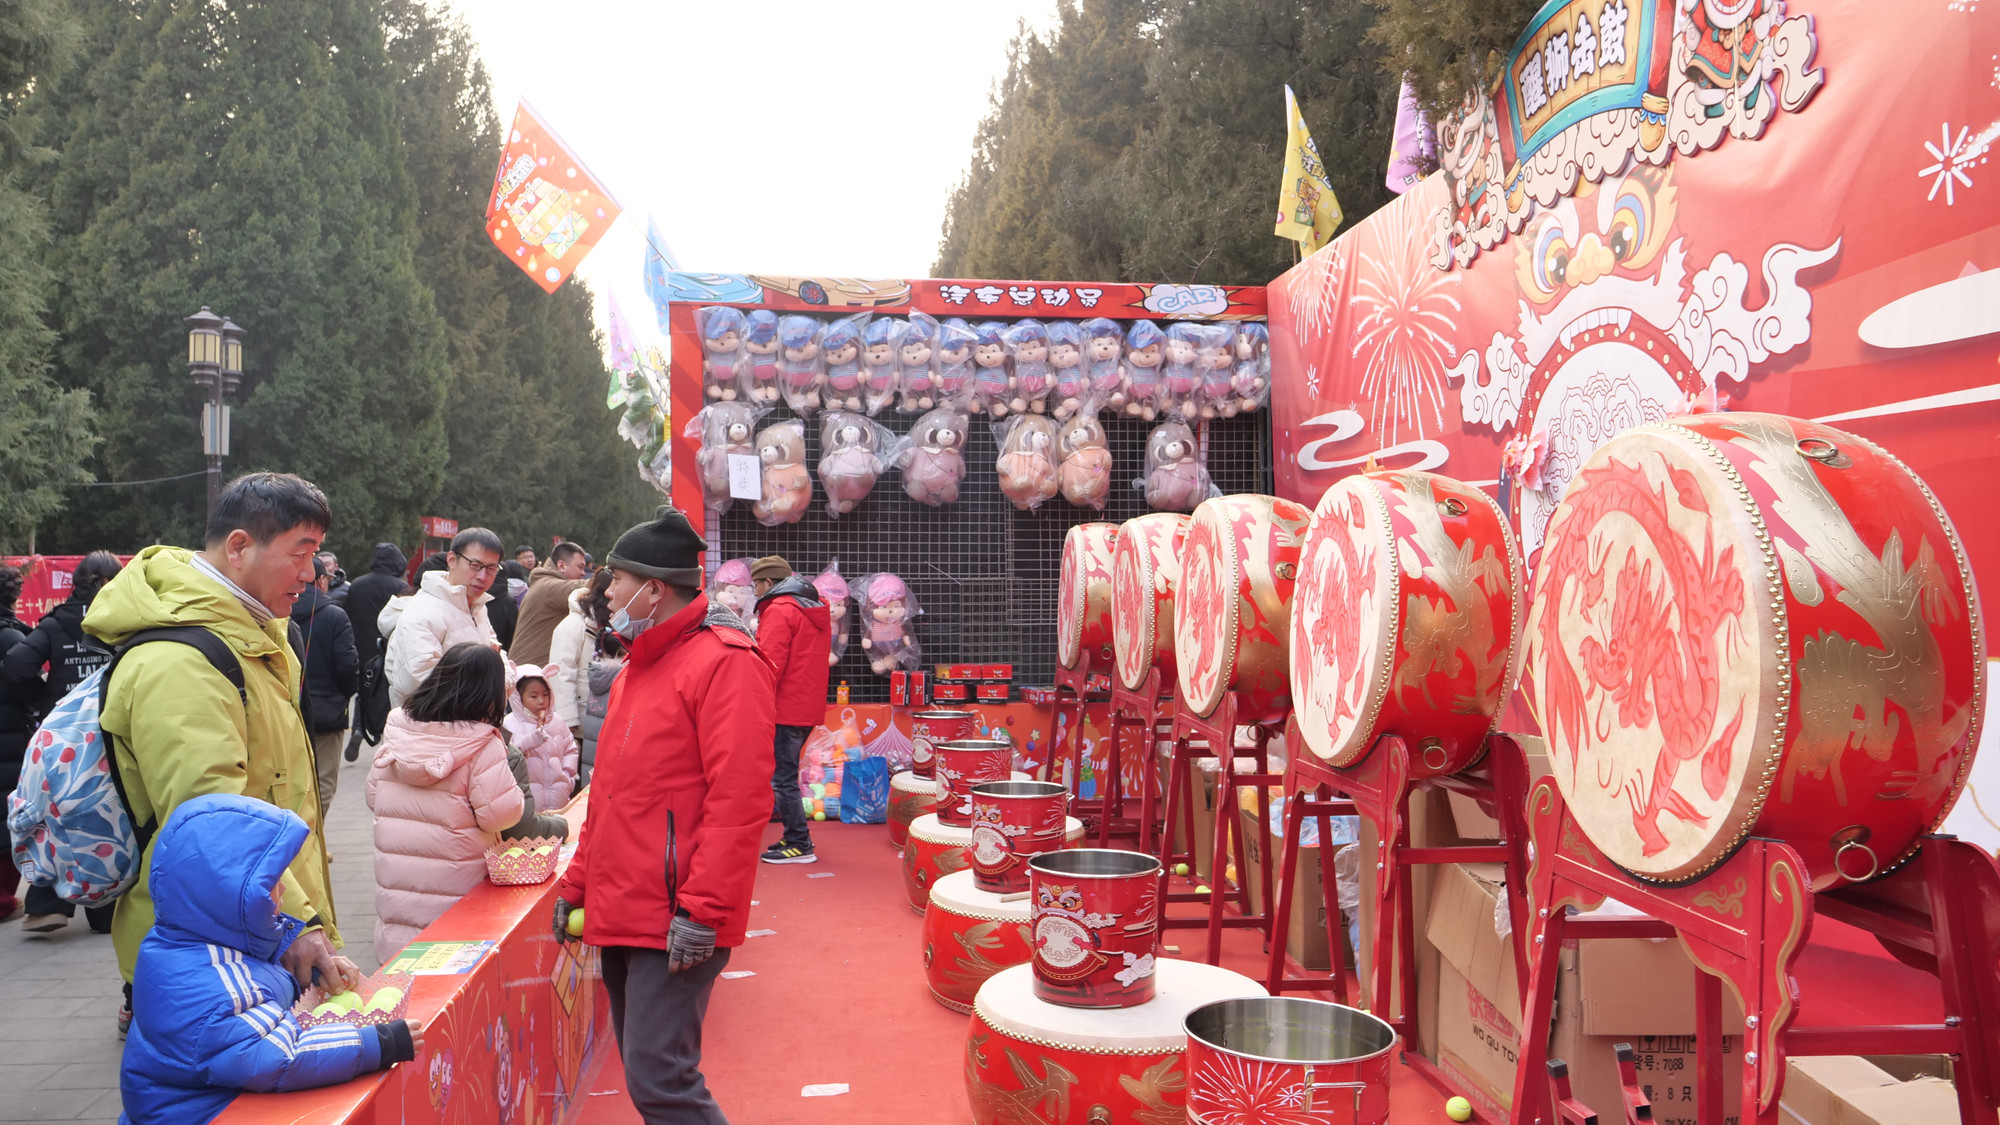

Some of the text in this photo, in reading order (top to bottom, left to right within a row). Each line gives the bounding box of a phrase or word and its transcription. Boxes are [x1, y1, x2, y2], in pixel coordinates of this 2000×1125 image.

[1519, 0, 1628, 120] 醒狮击鼓
[939, 285, 1102, 307] 汽车总动员
[1157, 288, 1216, 312] CAR
[1472, 1023, 1485, 1041] WO
[1486, 1035, 1500, 1053] QU
[1663, 1058, 1684, 1070] 7088
[1667, 1088, 1674, 1100] 8
[1681, 1086, 1692, 1101] 只
